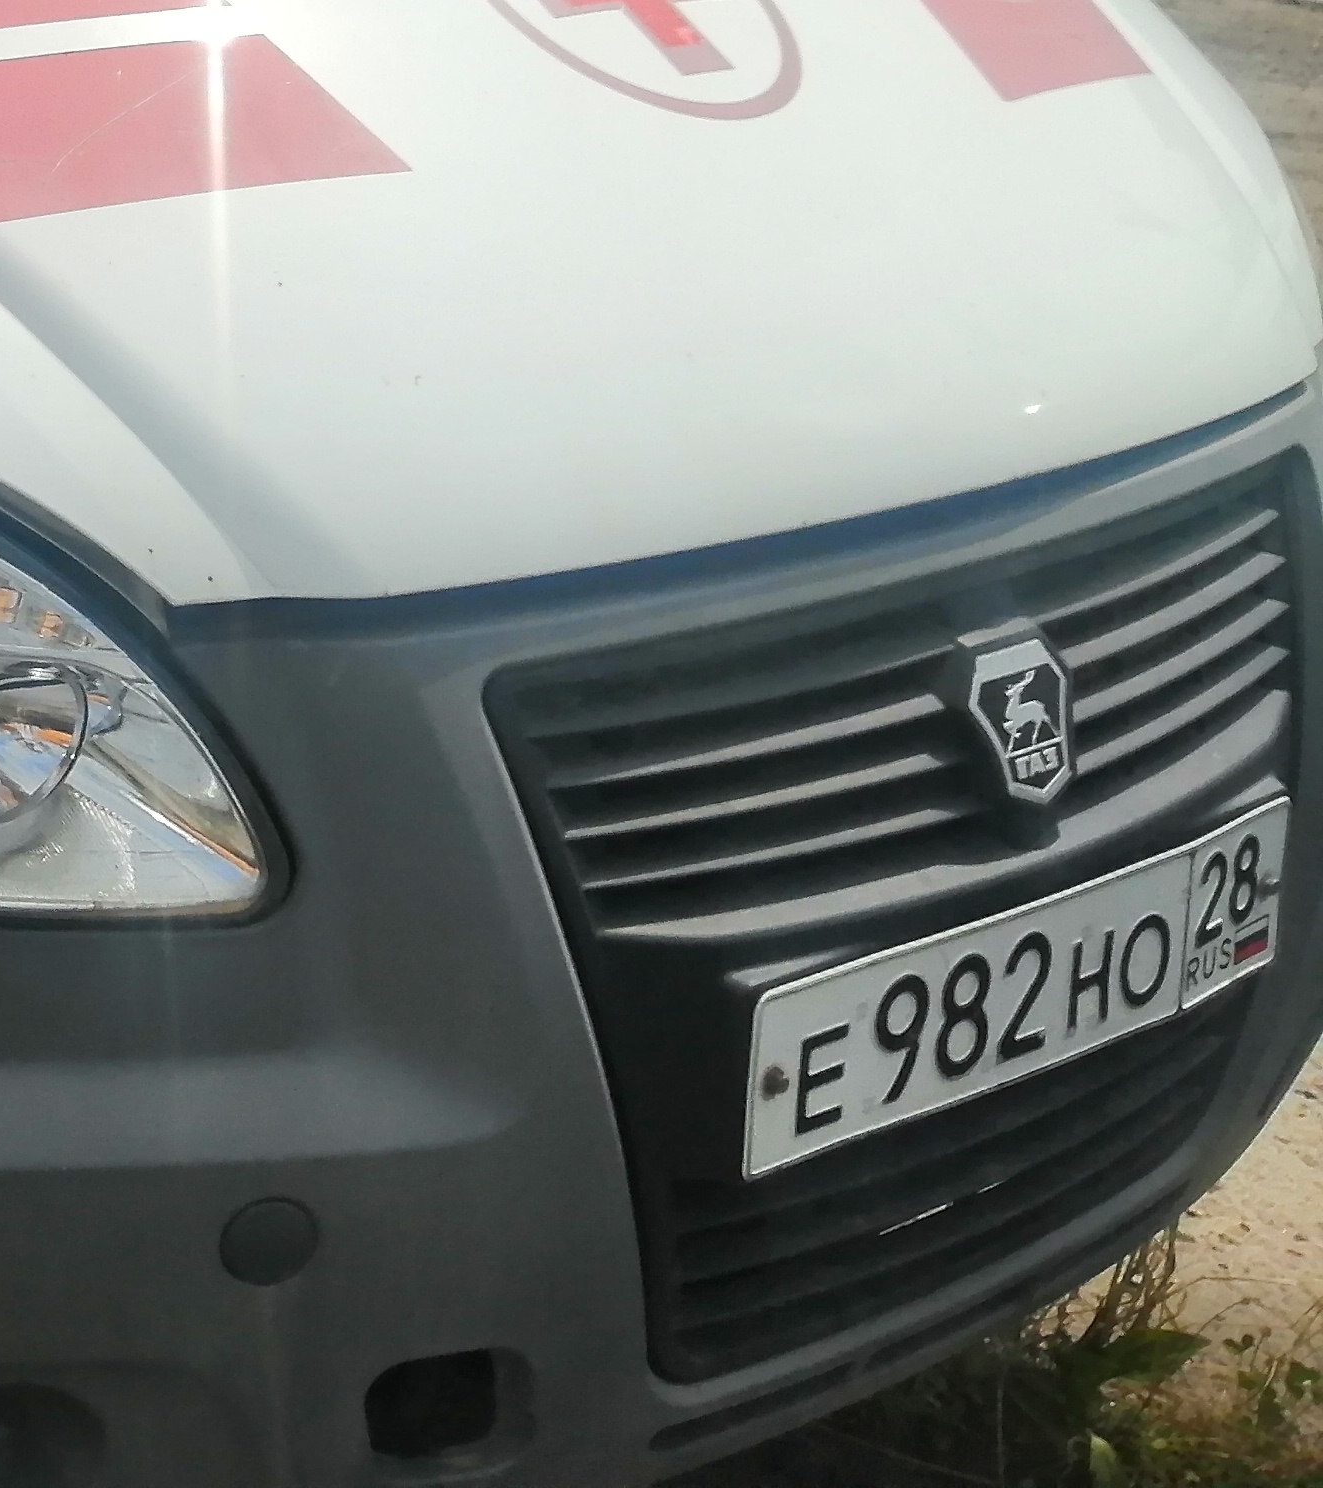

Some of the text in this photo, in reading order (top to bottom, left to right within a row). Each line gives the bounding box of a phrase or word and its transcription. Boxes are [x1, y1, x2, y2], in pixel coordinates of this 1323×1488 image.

[1015, 746, 1059, 779] ГАЗ
[1194, 833, 1261, 948] 28
[1186, 938, 1232, 992] RUS
